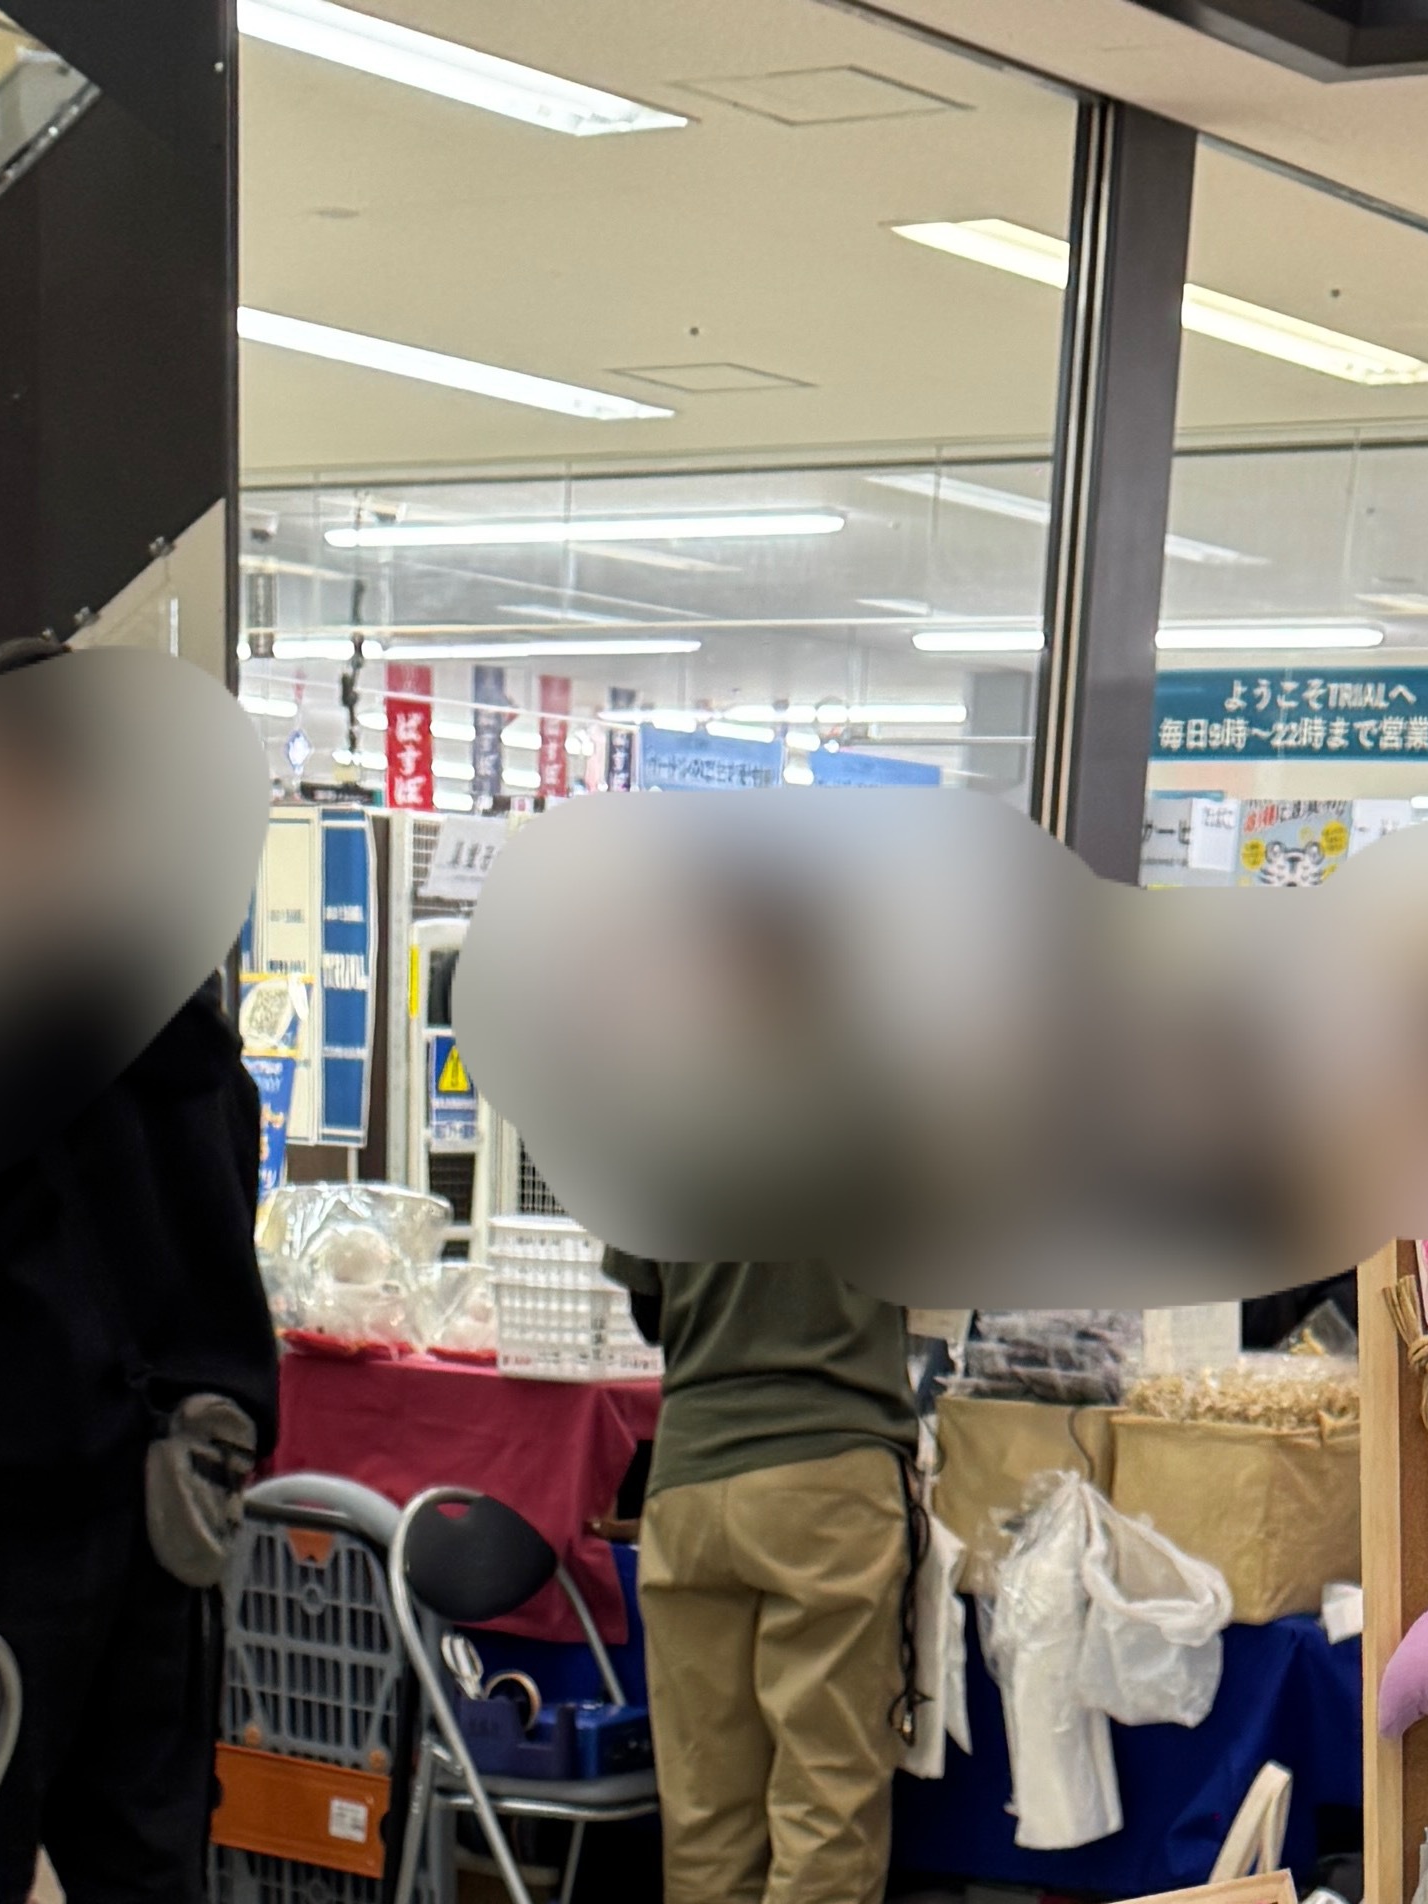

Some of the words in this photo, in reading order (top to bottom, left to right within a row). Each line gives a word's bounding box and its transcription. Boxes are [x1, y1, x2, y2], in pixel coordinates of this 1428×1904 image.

[1224, 678, 1417, 713] ようこそTRIALへ
